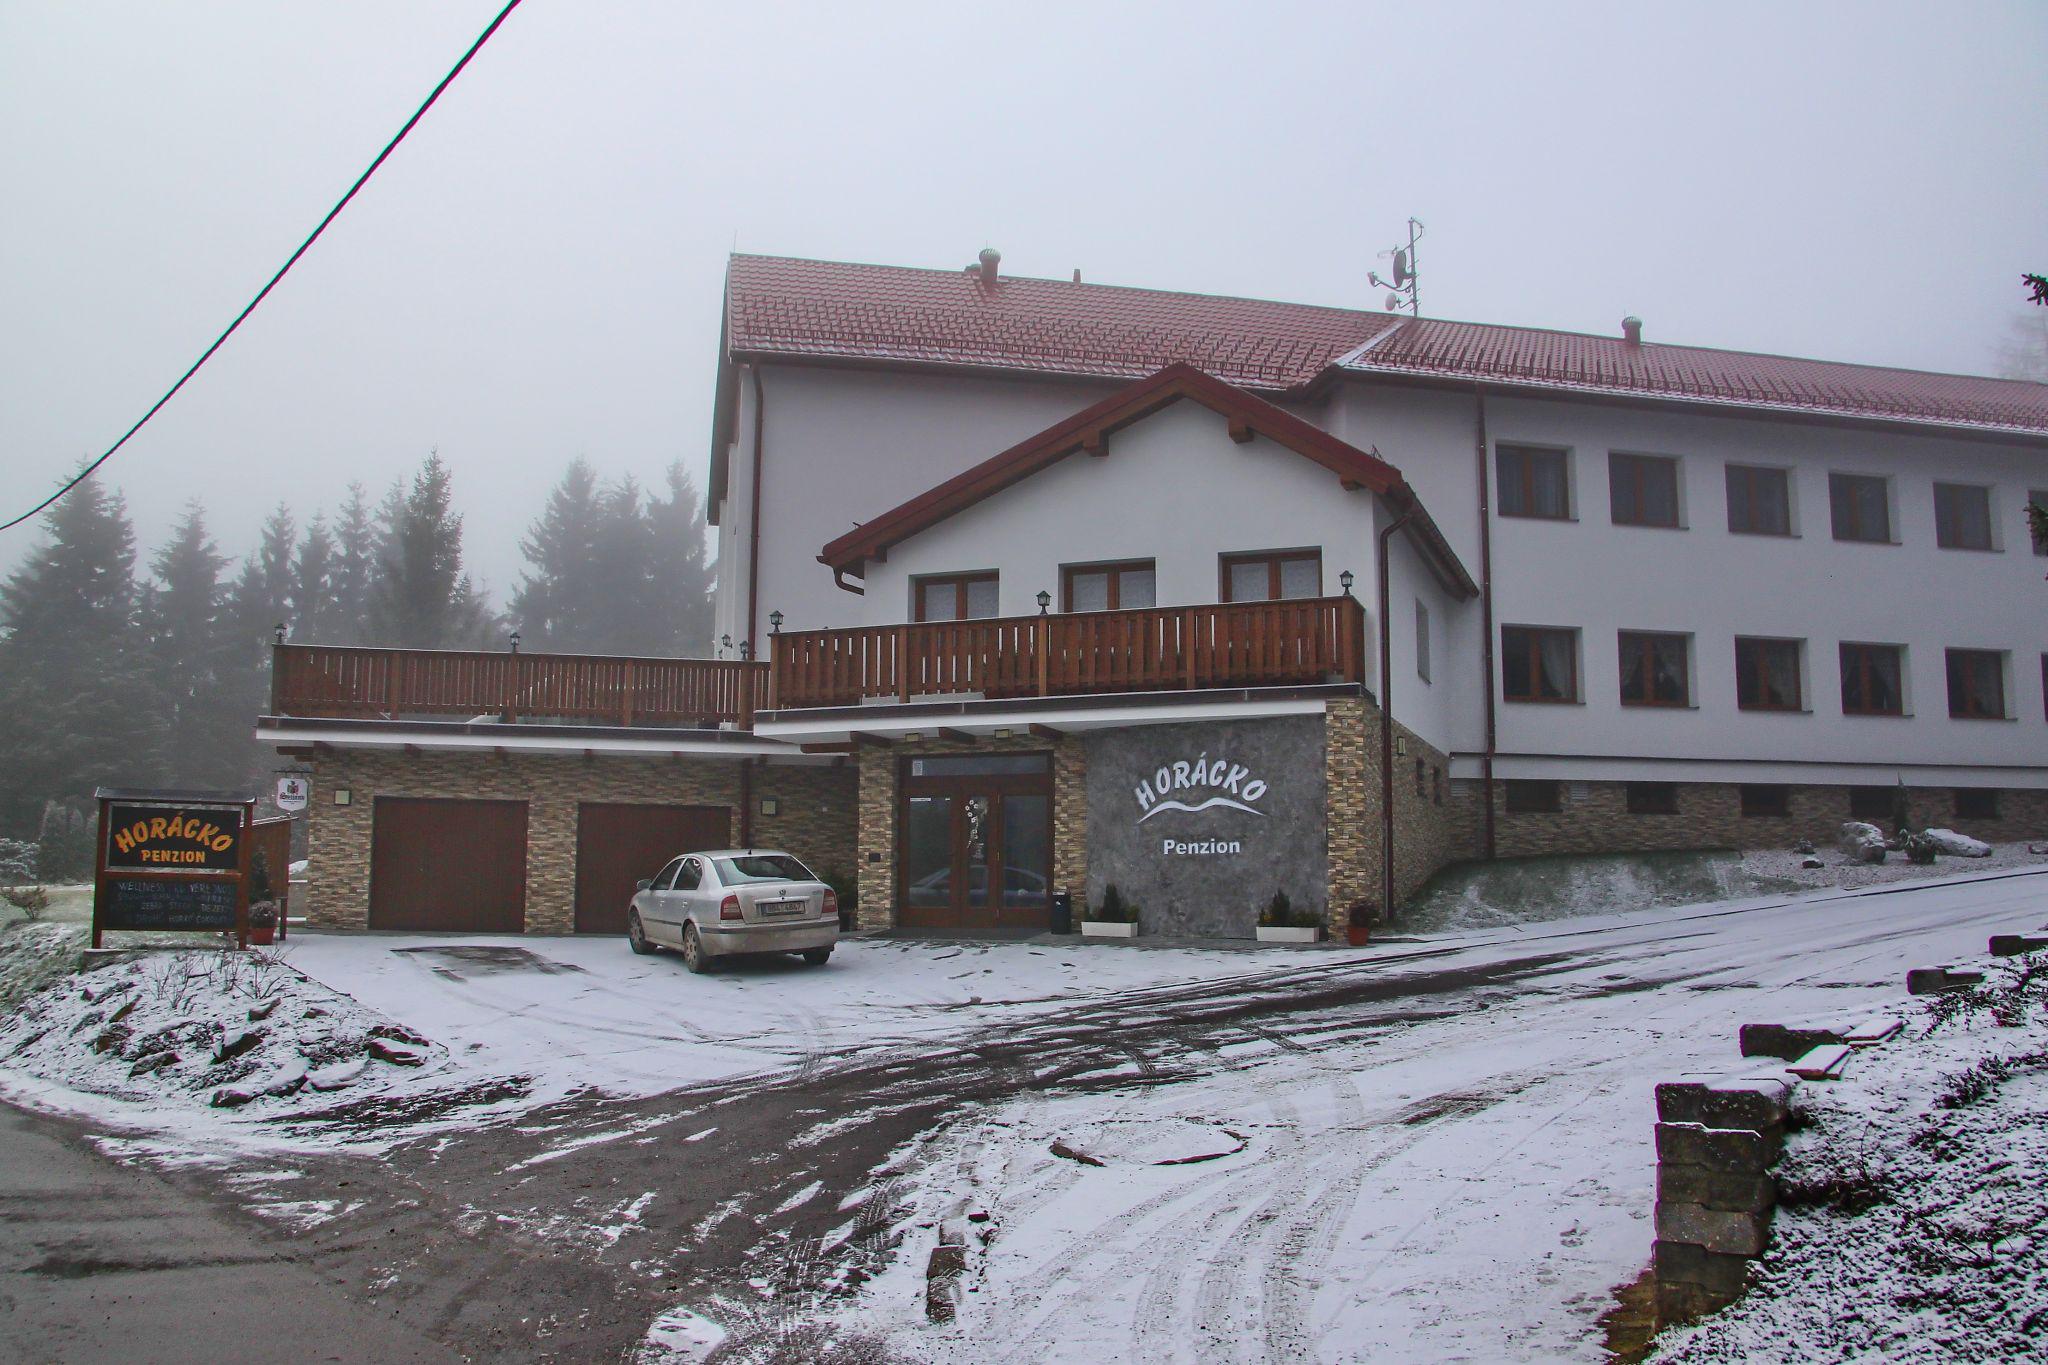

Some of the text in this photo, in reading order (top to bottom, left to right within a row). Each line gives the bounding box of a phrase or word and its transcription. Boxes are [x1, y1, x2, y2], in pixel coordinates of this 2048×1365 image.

[1135, 751, 1268, 811] HORÁCKO
[114, 810, 234, 854] HORÁCKO
[1163, 838, 1241, 855] Penzion
[141, 850, 206, 863] PENZION
